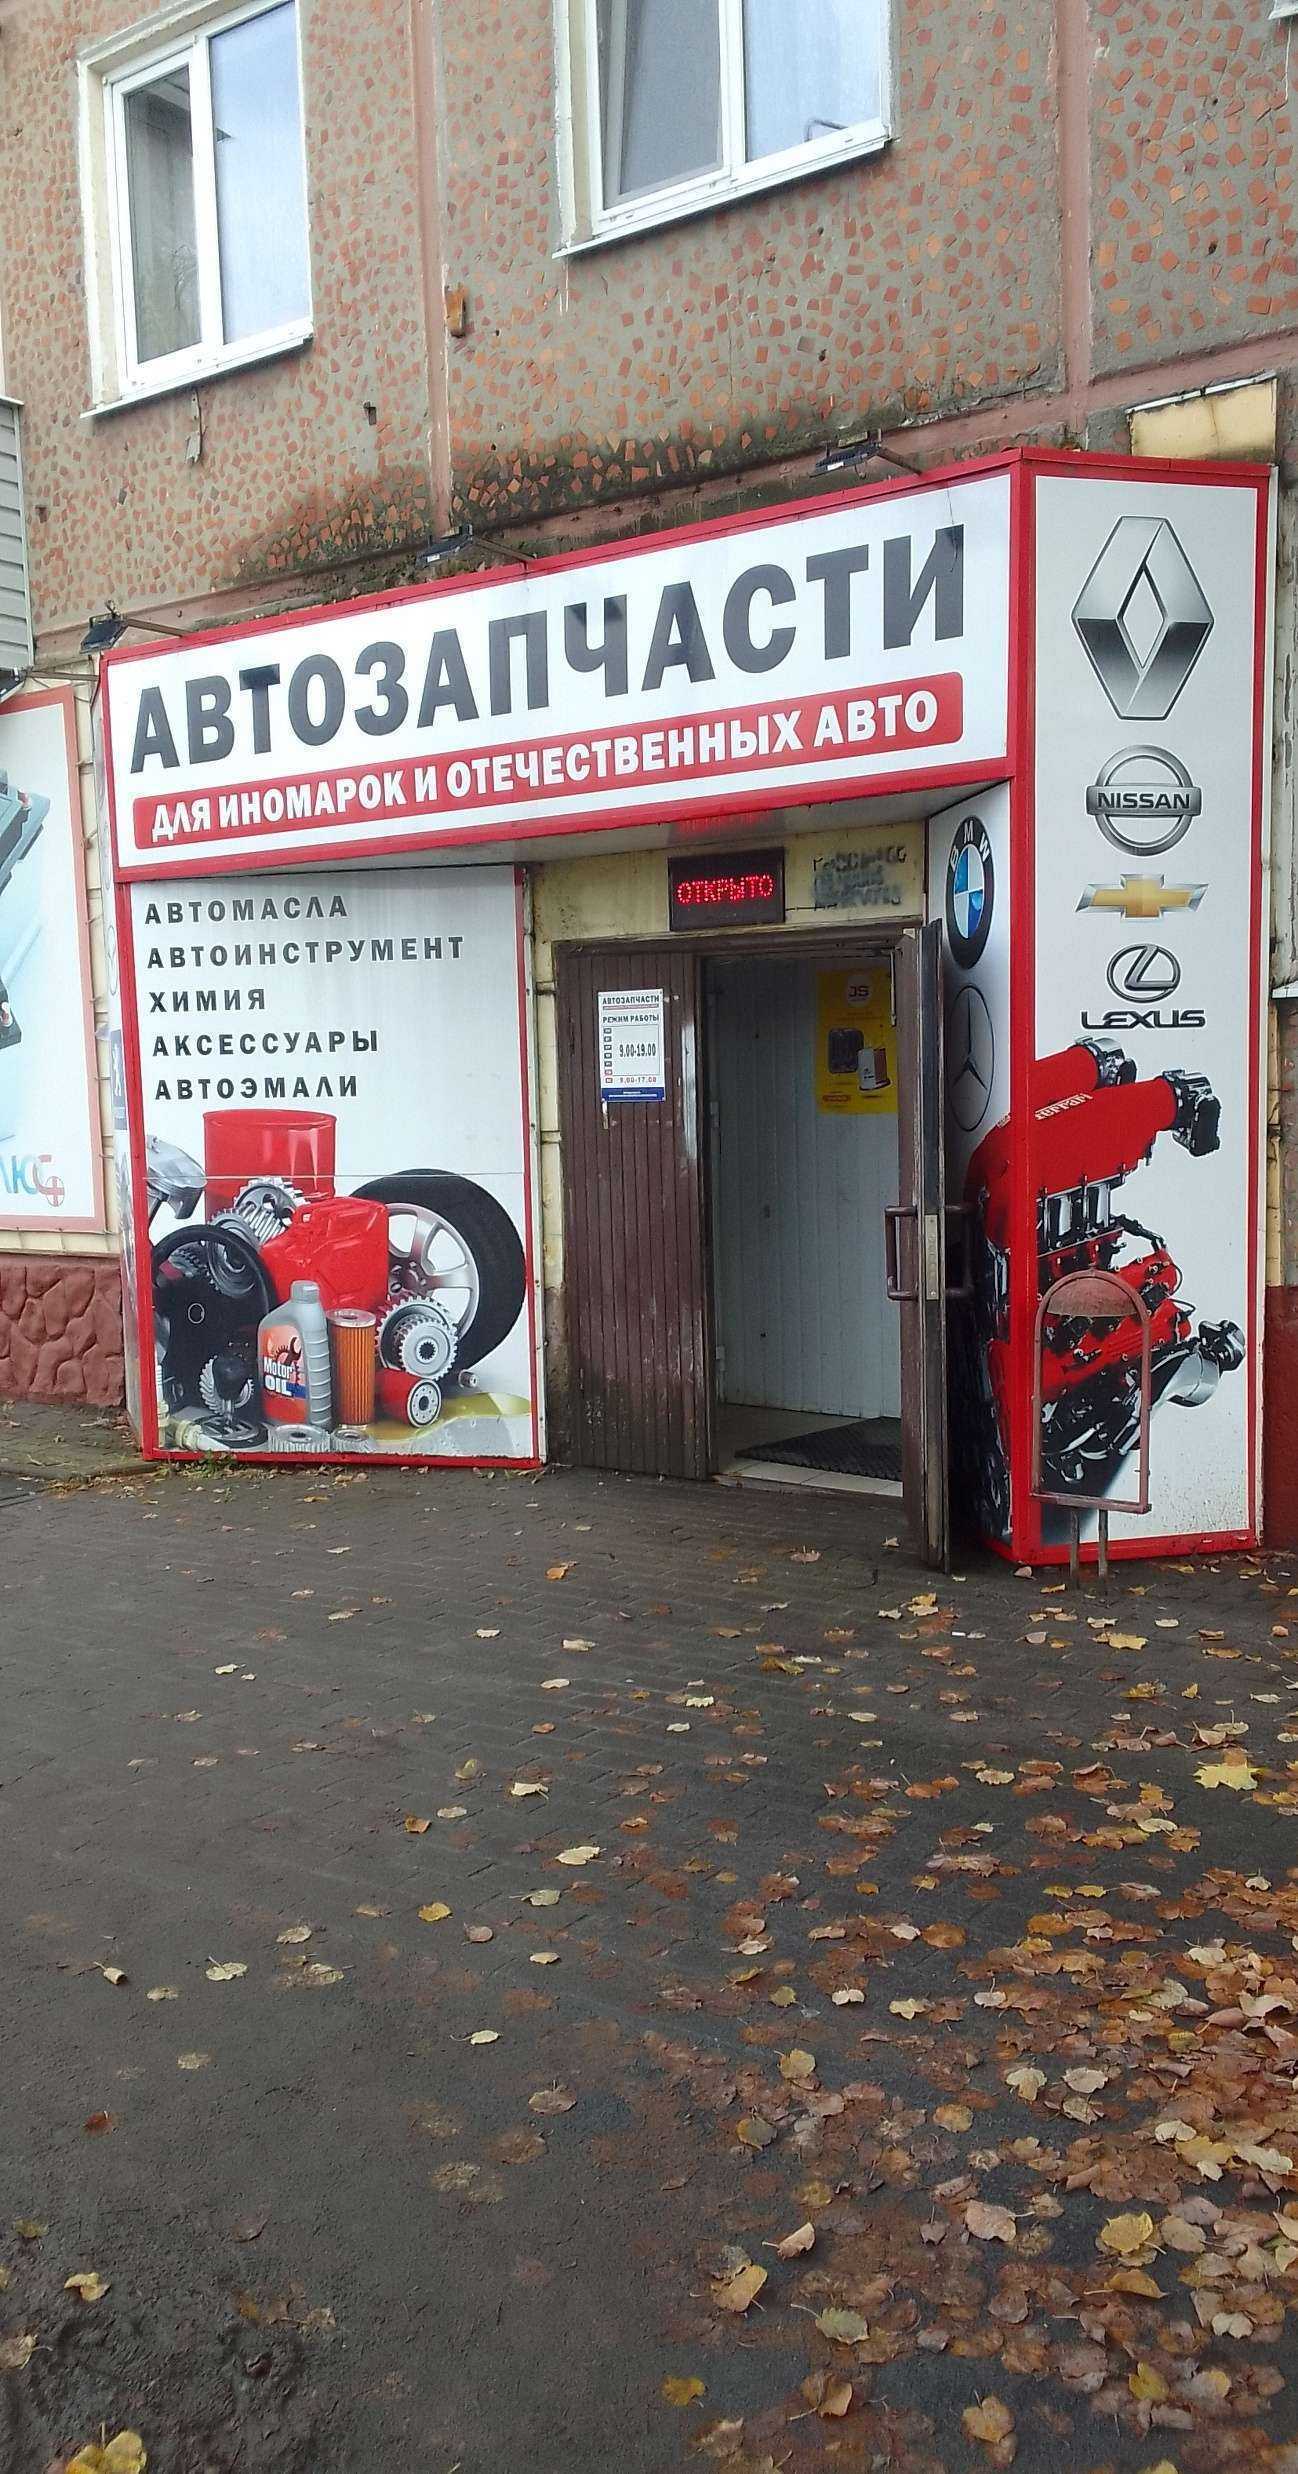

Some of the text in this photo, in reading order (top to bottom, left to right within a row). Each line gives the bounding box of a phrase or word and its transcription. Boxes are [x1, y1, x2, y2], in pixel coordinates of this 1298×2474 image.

[130, 524, 964, 773] АВТОЗАПЧАСТИ
[152, 690, 938, 843] ДЛЯ ИНОМАРОК И ОТЕЧЕСТВЕННЫХ АВТО
[1097, 792, 1191, 810] NISSAN
[950, 820, 990, 872] BMW
[677, 875, 773, 903] ОТКРЫТО
[145, 895, 348, 925] АВТОМАСЛА
[147, 936, 464, 969] АВТОИНСТРУМЕНТ
[149, 988, 265, 1013] ХИМИЯ
[602, 994, 660, 1005] АВТОЗАПЧАСТИ
[602, 1013, 659, 1024] РЕЖИМ РАБОТЫ
[1081, 1009, 1205, 1029] LEXUS
[152, 1030, 378, 1057] АКСЕССУАРЫ
[155, 1075, 358, 1100] АВТОЭМАЛИ
[264, 1356, 293, 1380] Motor
[264, 1374, 293, 1397] OIL
